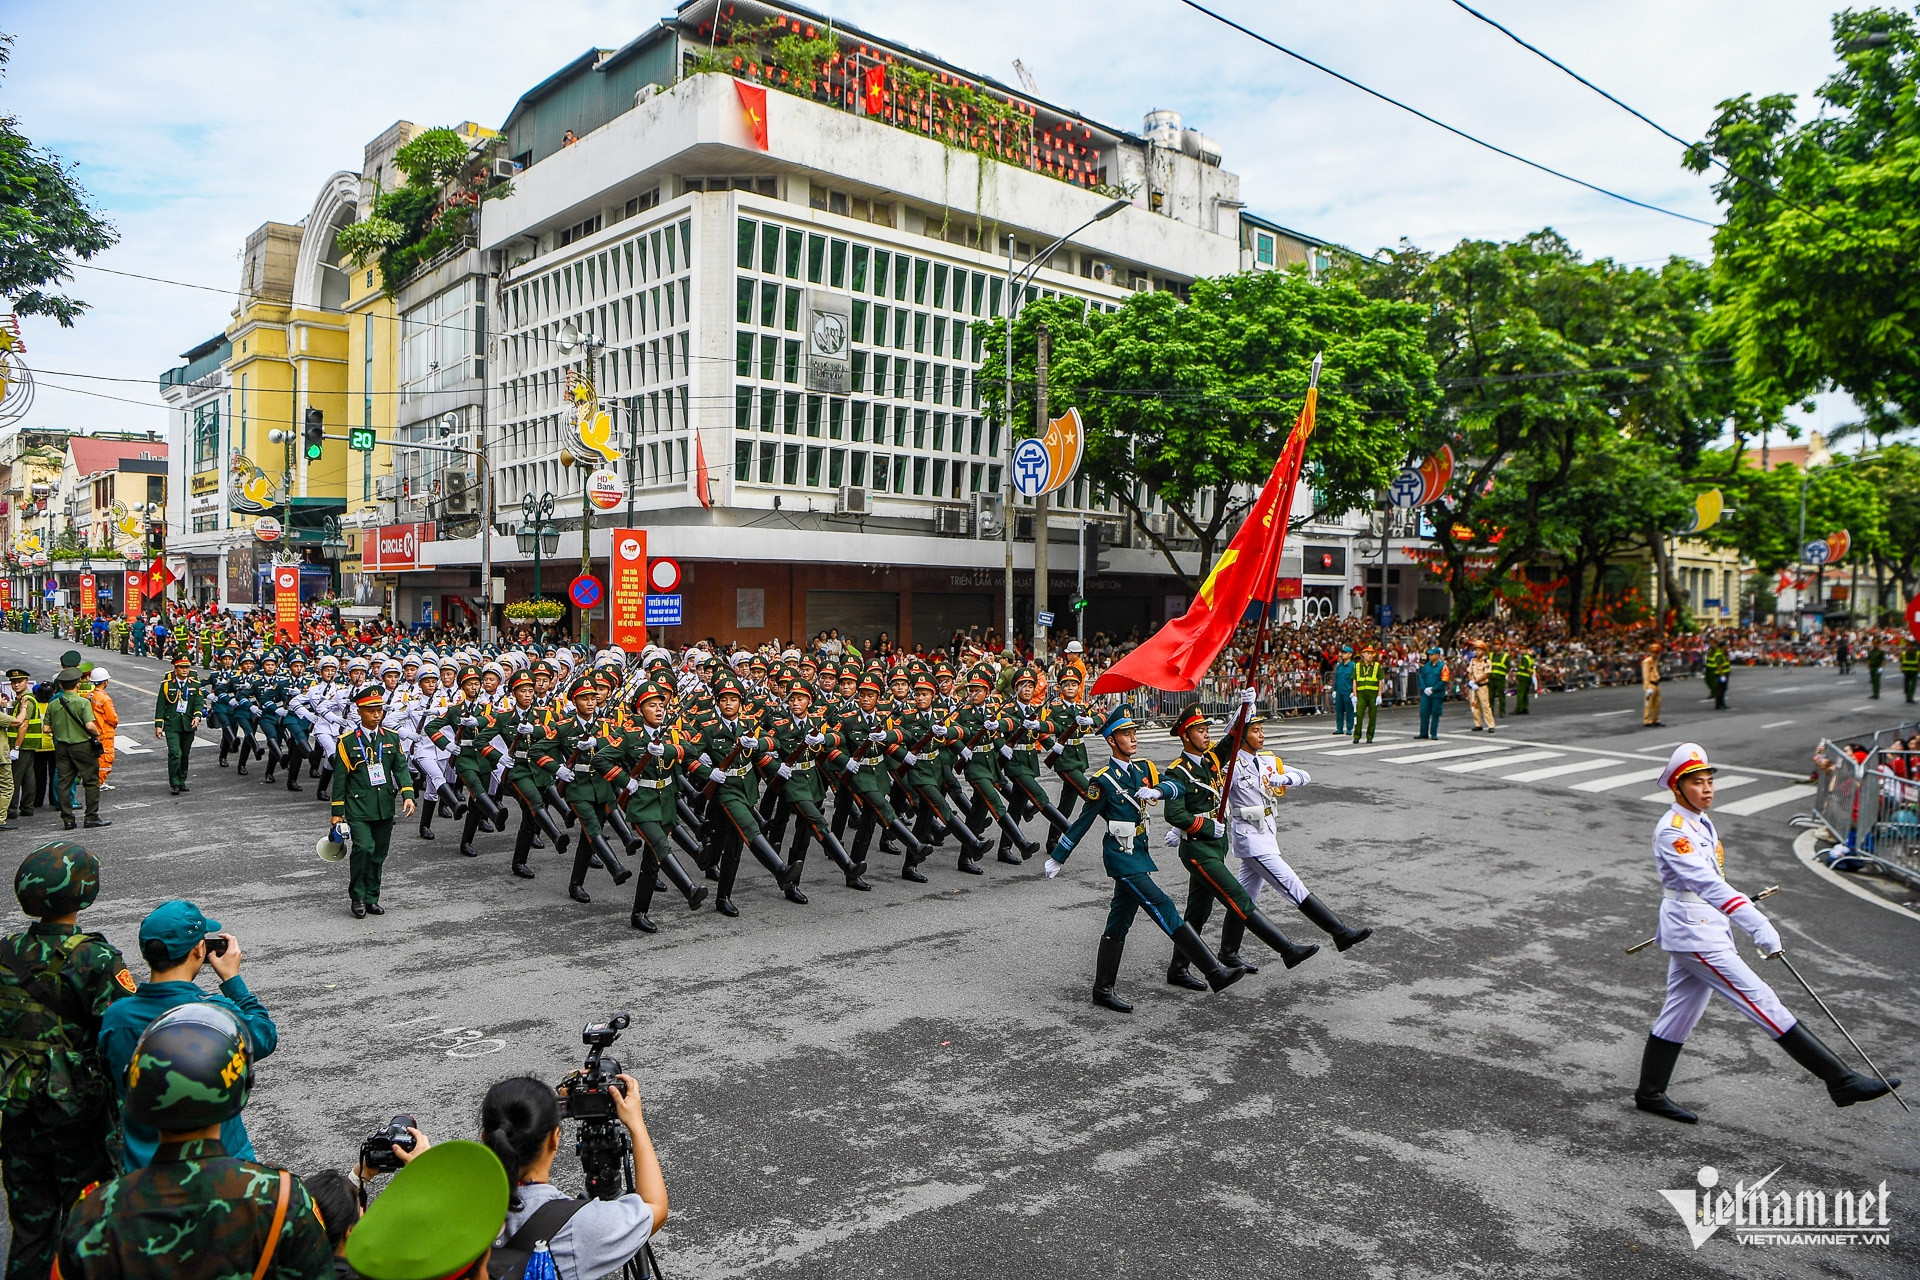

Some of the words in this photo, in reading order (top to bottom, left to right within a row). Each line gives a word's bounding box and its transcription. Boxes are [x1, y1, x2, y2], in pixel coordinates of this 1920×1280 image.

[353, 431, 372, 448] 20
[596, 475, 608, 483] HD
[596, 482, 615, 491] Bank
[381, 538, 403, 554] CIRCLE
[1014, 577, 1032, 589] HUẬT
[1050, 579, 1078, 589] PAINTIN
